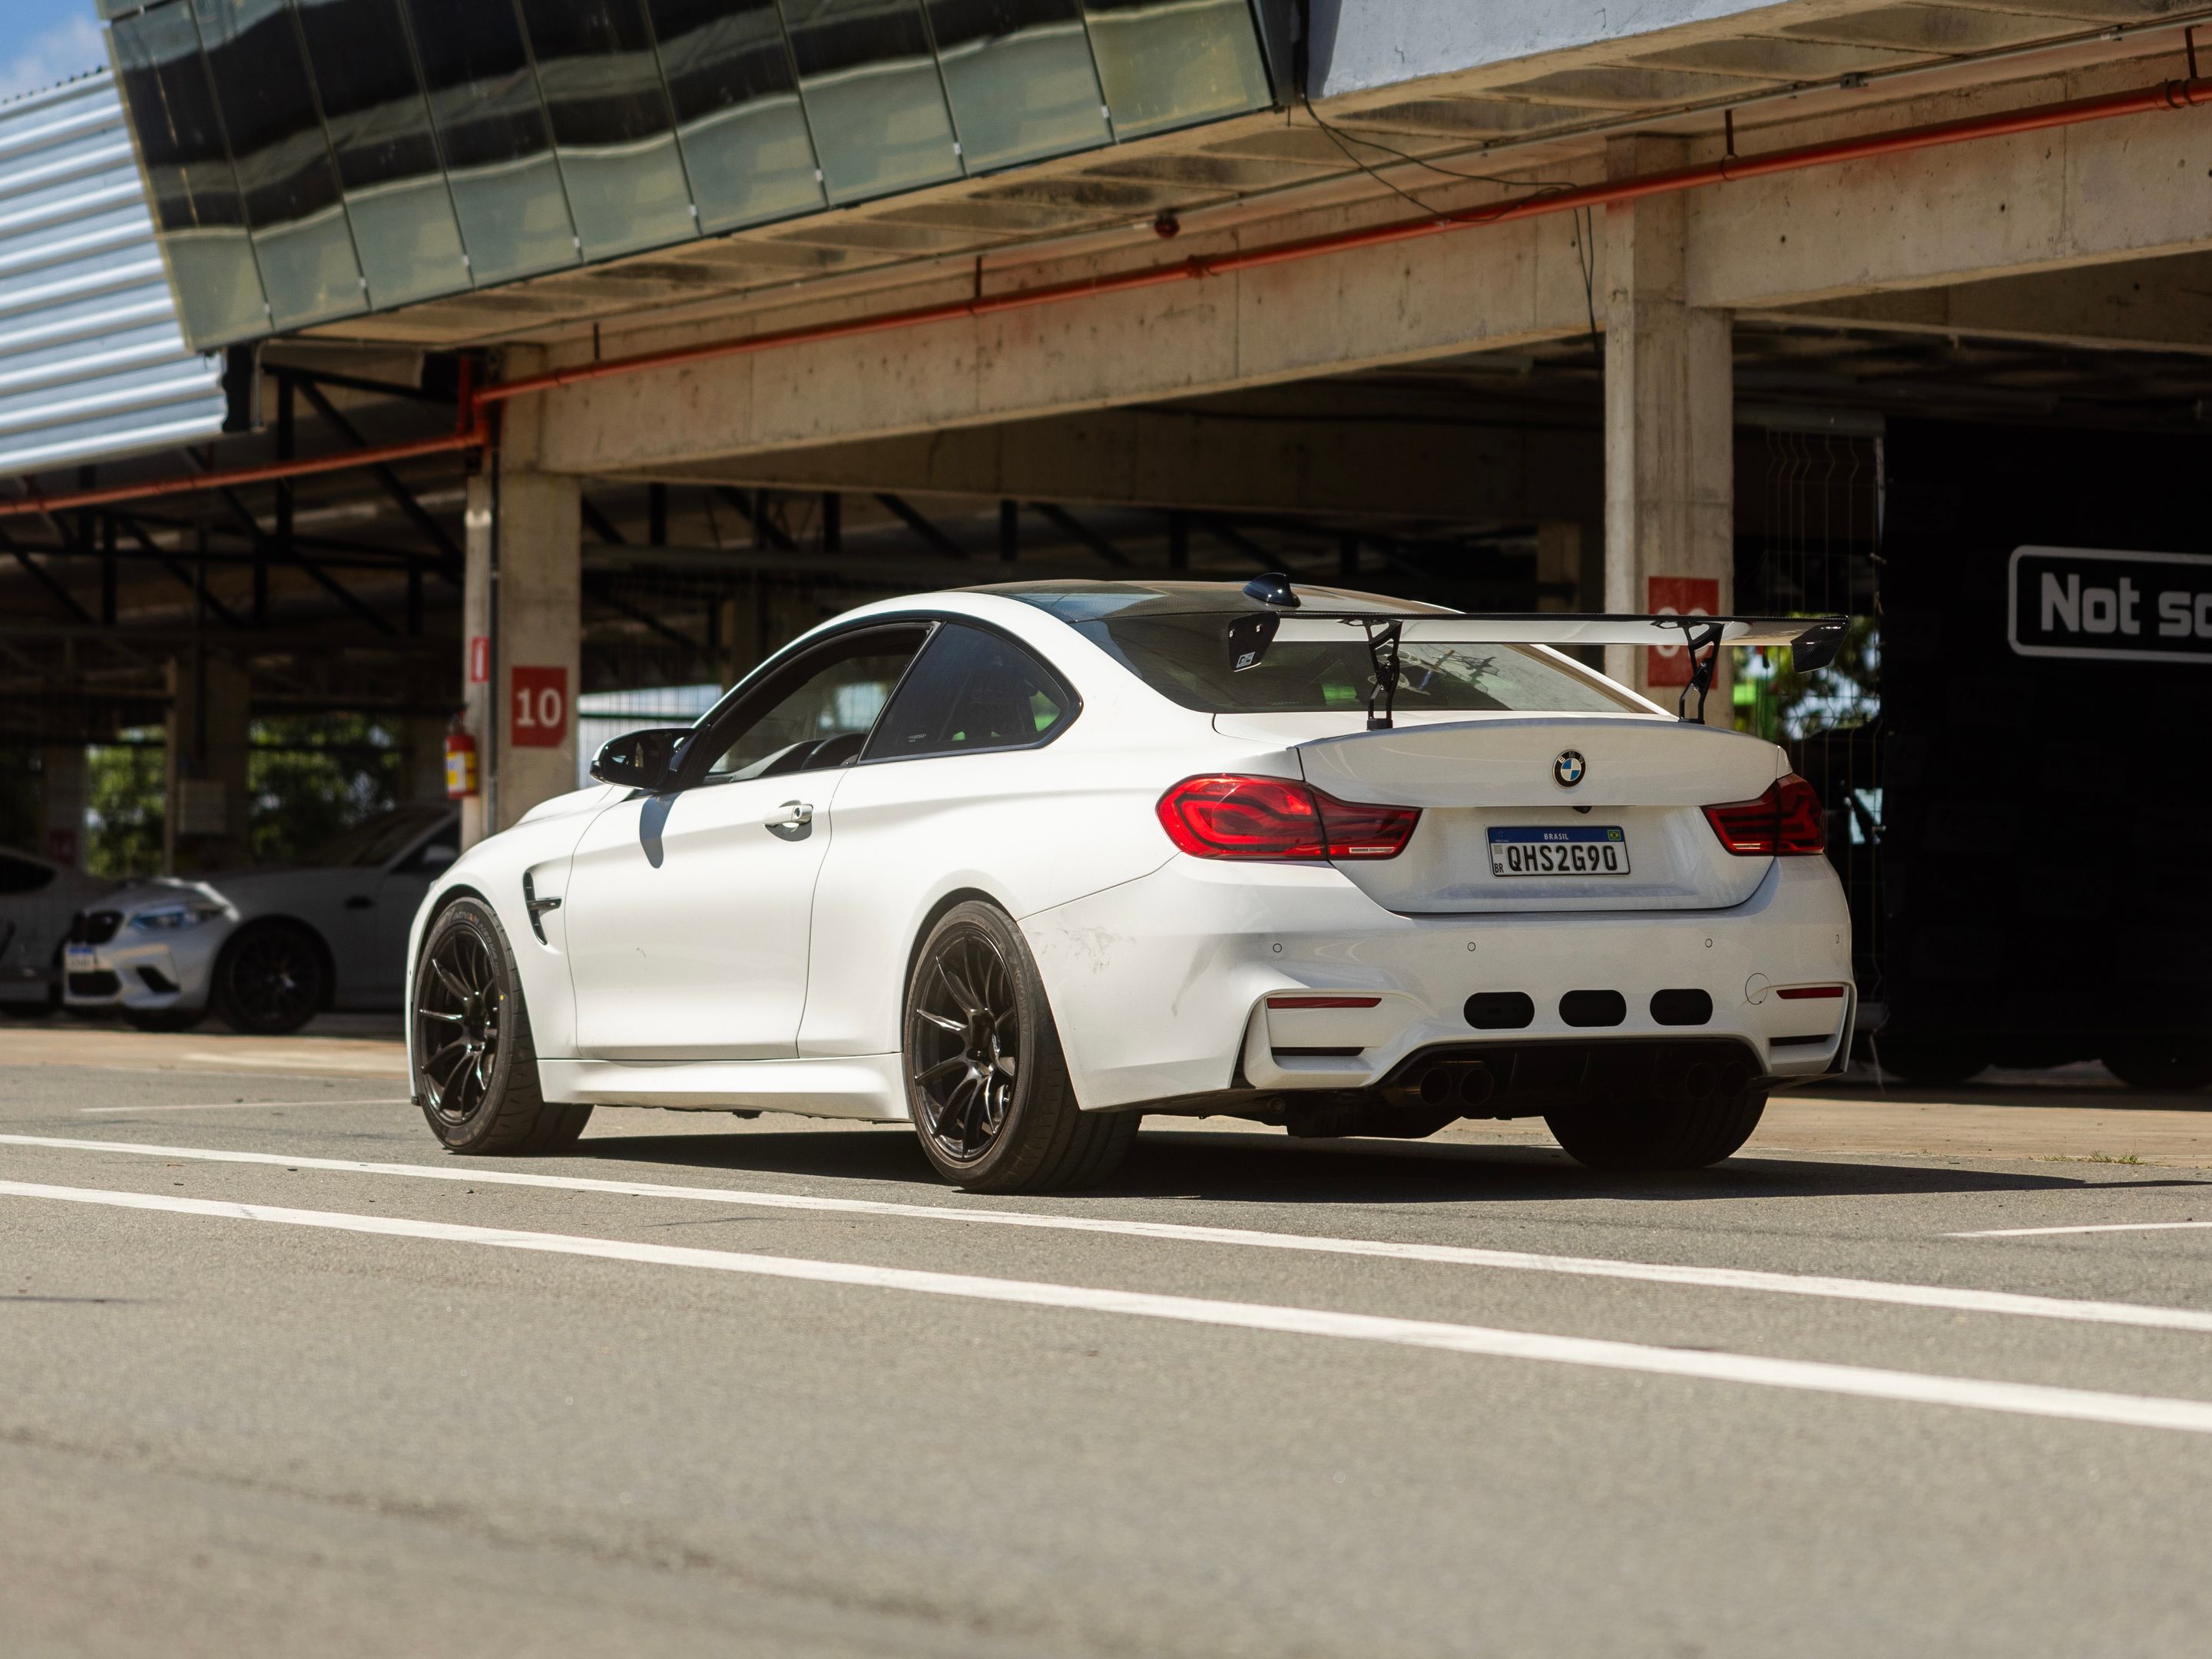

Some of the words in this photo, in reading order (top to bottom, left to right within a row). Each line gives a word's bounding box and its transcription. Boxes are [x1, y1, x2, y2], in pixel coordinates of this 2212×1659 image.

[2041, 572, 2141, 635] Not
[517, 687, 562, 727] 10
[1558, 751, 1584, 764] BMW
[1544, 833, 1569, 841] BRASIL
[1494, 863, 1505, 873] BR
[1507, 845, 1618, 872] QHS2G90
